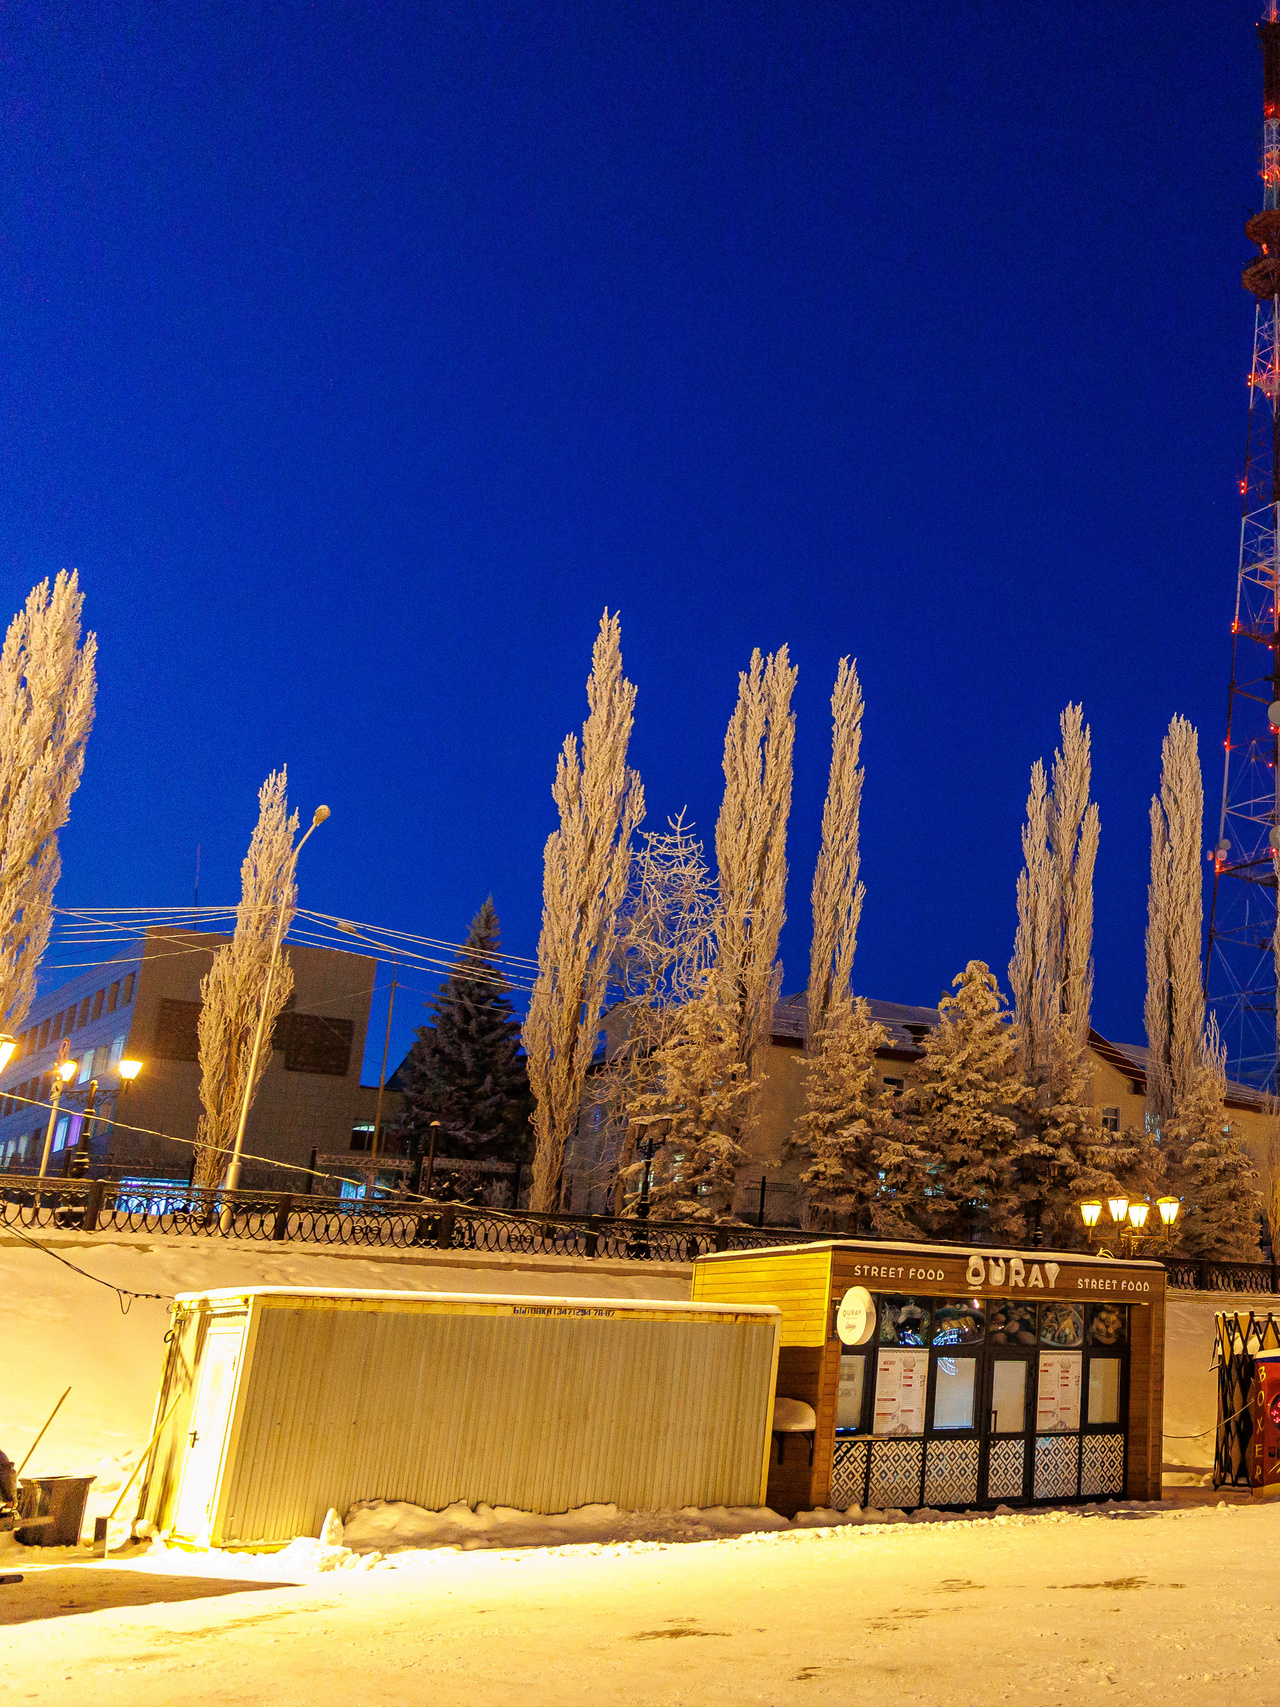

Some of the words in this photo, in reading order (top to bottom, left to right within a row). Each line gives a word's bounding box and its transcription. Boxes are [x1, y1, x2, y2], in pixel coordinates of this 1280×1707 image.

[854, 1264, 905, 1279] STREET
[909, 1267, 945, 1281] FOOD
[1077, 1277, 1118, 1291] STREET
[1121, 1280, 1151, 1292] FOOD
